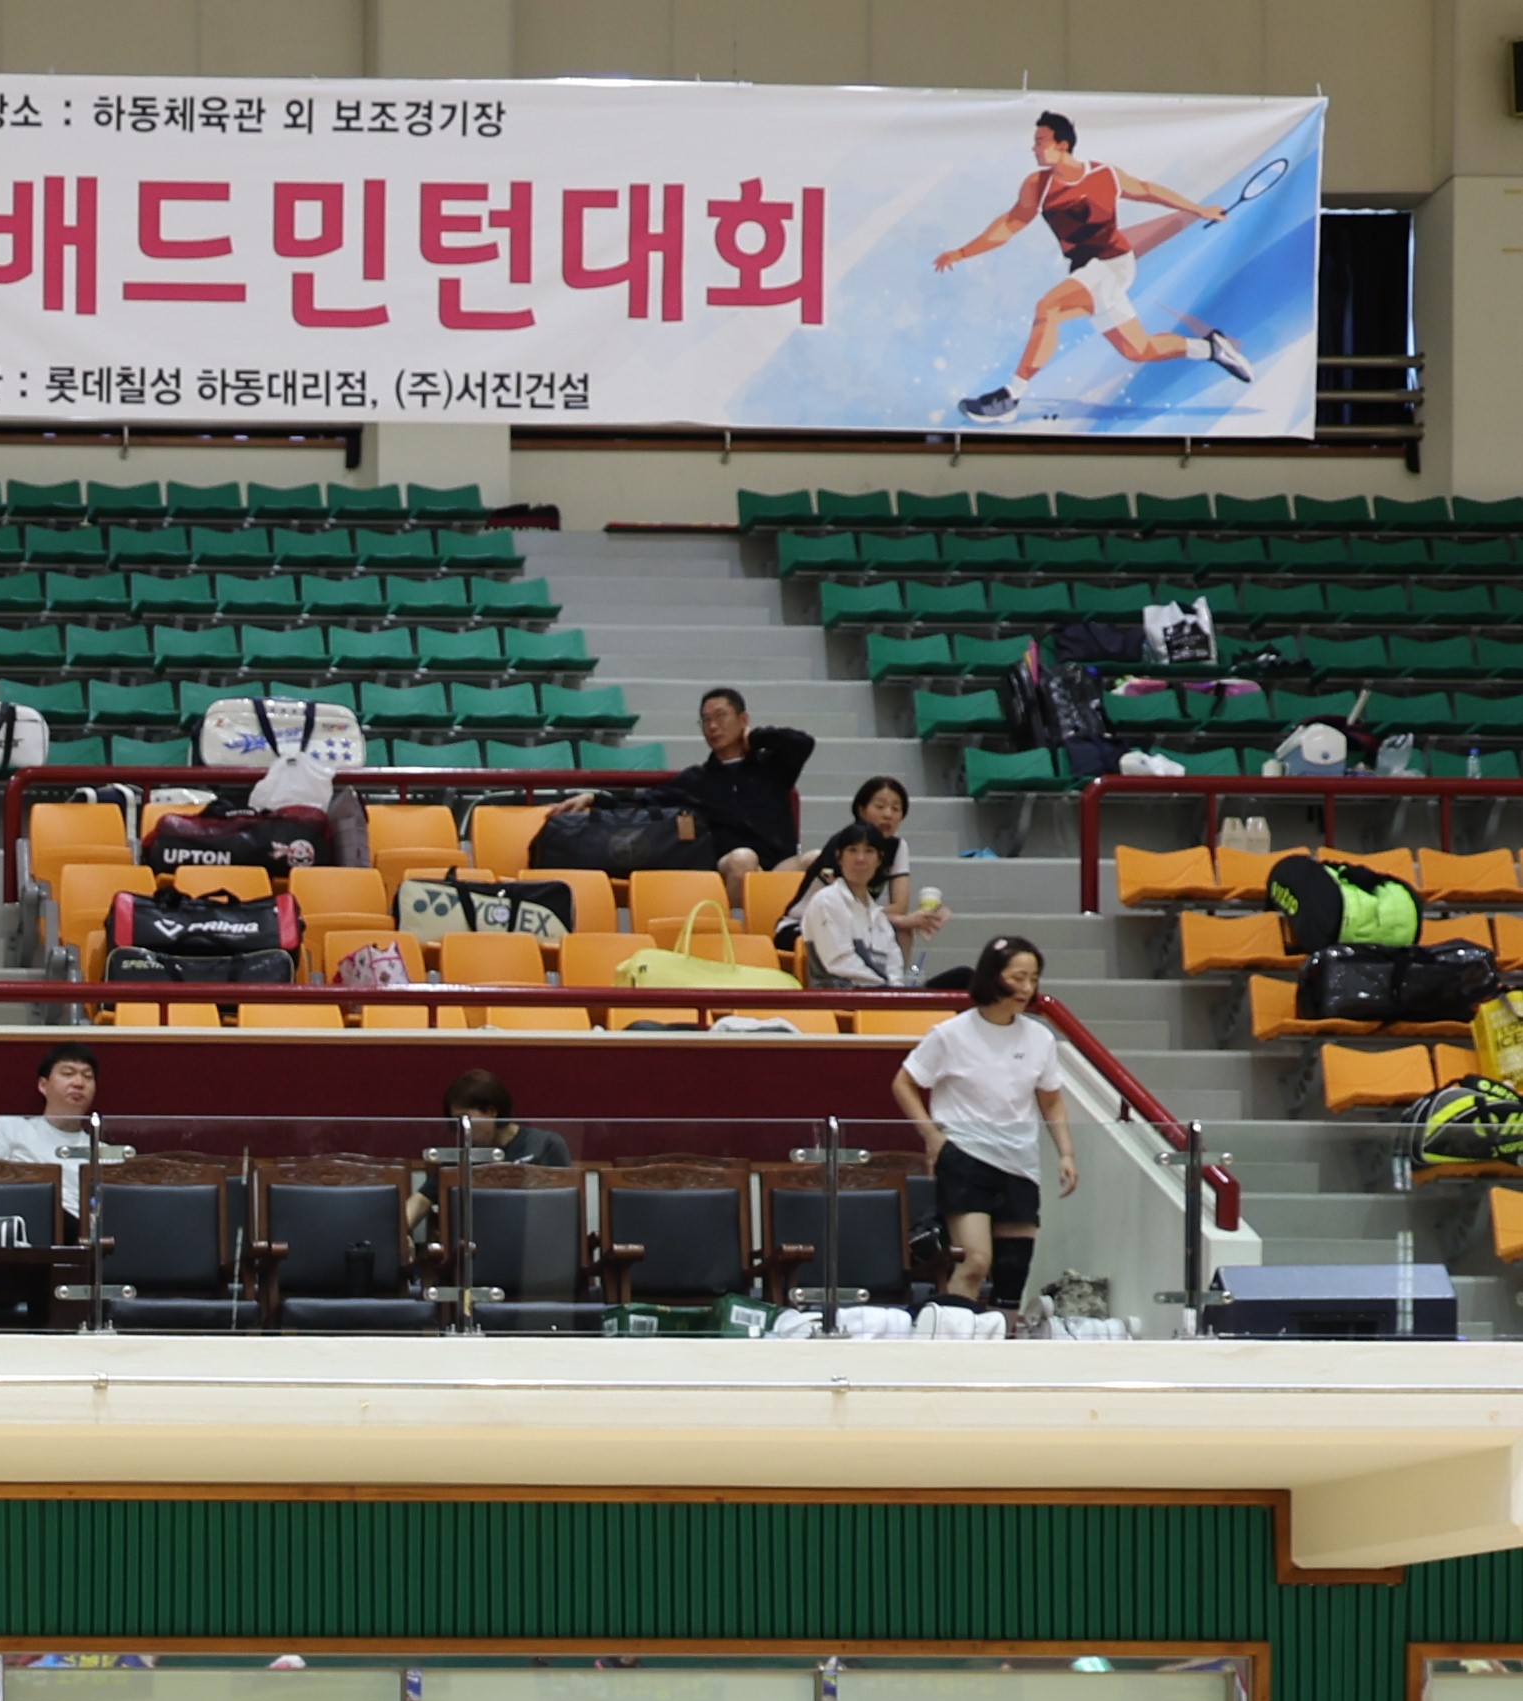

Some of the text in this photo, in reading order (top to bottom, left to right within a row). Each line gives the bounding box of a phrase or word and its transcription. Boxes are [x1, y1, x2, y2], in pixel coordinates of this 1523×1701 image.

[93, 94, 267, 134] 하동체육관
[282, 97, 315, 135] 외
[331, 99, 507, 138] 보조경기장
[45, 364, 182, 405] 롯데칠성
[196, 367, 378, 410] 하동대리점,
[394, 367, 590, 411] (주)서진건설
[163, 848, 231, 866] UPTON
